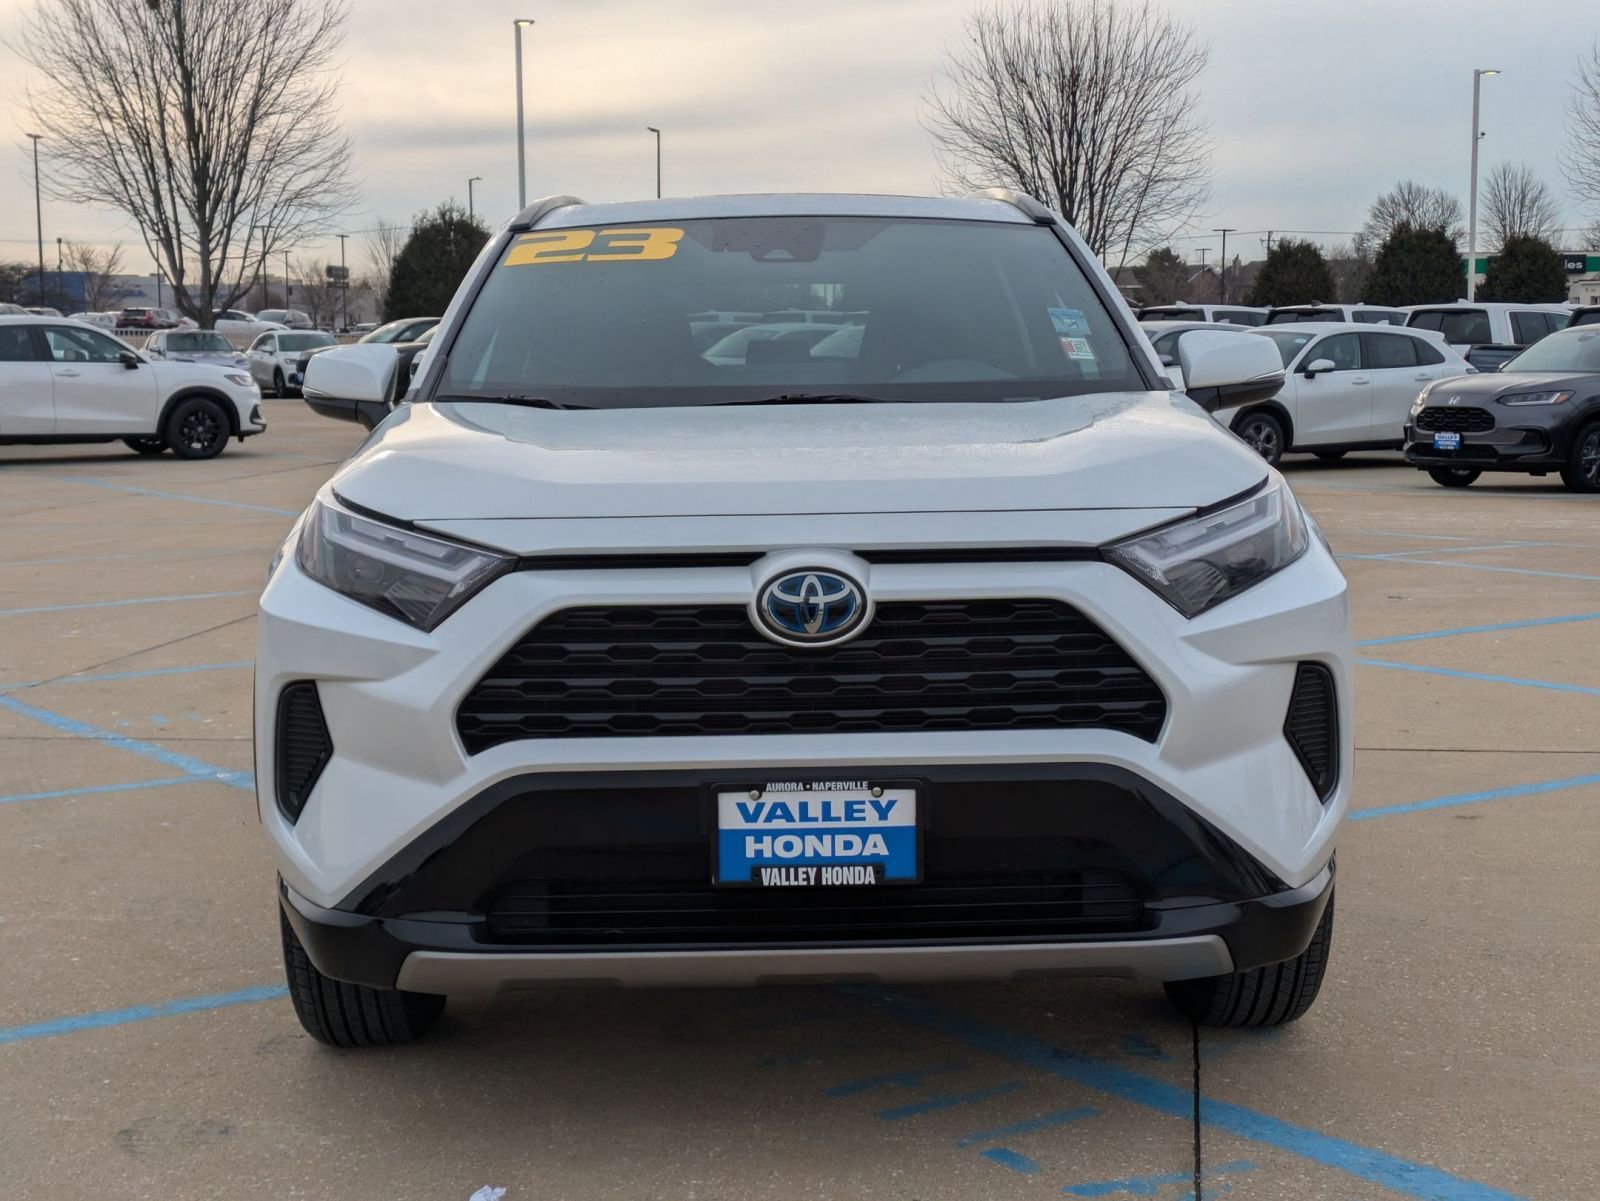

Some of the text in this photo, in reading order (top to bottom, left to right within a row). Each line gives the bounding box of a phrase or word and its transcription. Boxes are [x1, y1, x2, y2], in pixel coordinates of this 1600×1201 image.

[504, 227, 684, 266] 23
[766, 781, 869, 792] AURORA NAPERVILLE
[736, 799, 898, 824] VALLEY
[745, 833, 889, 858] HONDA
[761, 865, 876, 886] VALLEY HONDA
